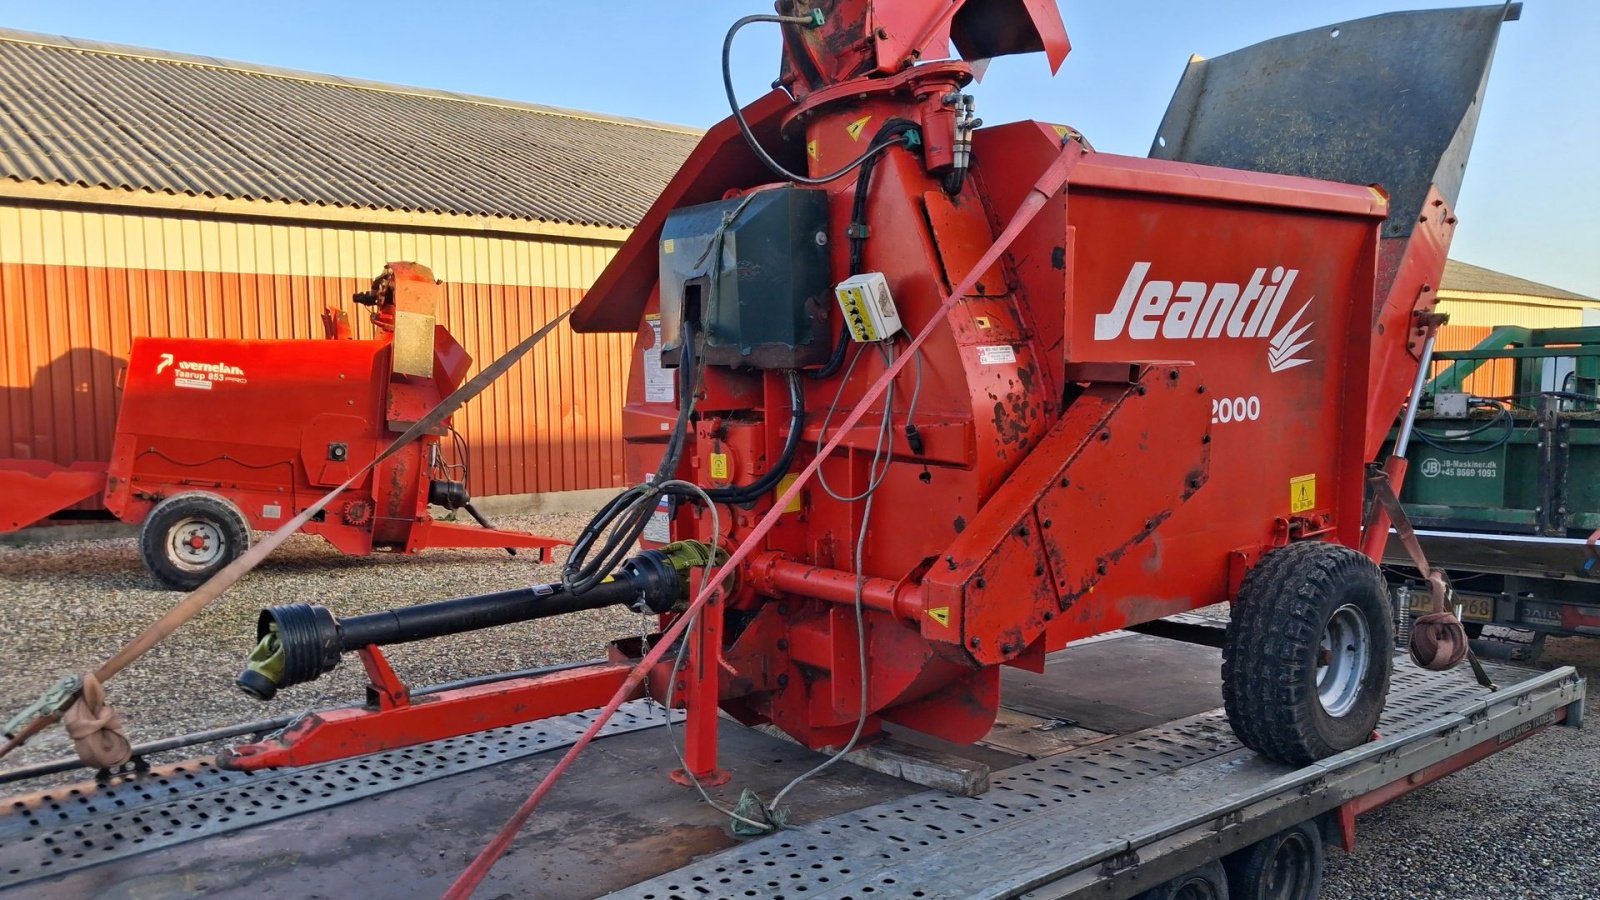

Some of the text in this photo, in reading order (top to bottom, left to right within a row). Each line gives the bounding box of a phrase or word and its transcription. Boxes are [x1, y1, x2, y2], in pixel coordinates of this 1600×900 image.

[1094, 261, 1299, 340] Jeantil
[175, 369, 205, 380] Taarup
[208, 372, 225, 382] 853
[1423, 462, 1438, 473] JB
[1441, 468, 1455, 476] +45
[1477, 469, 1497, 478] 1093
